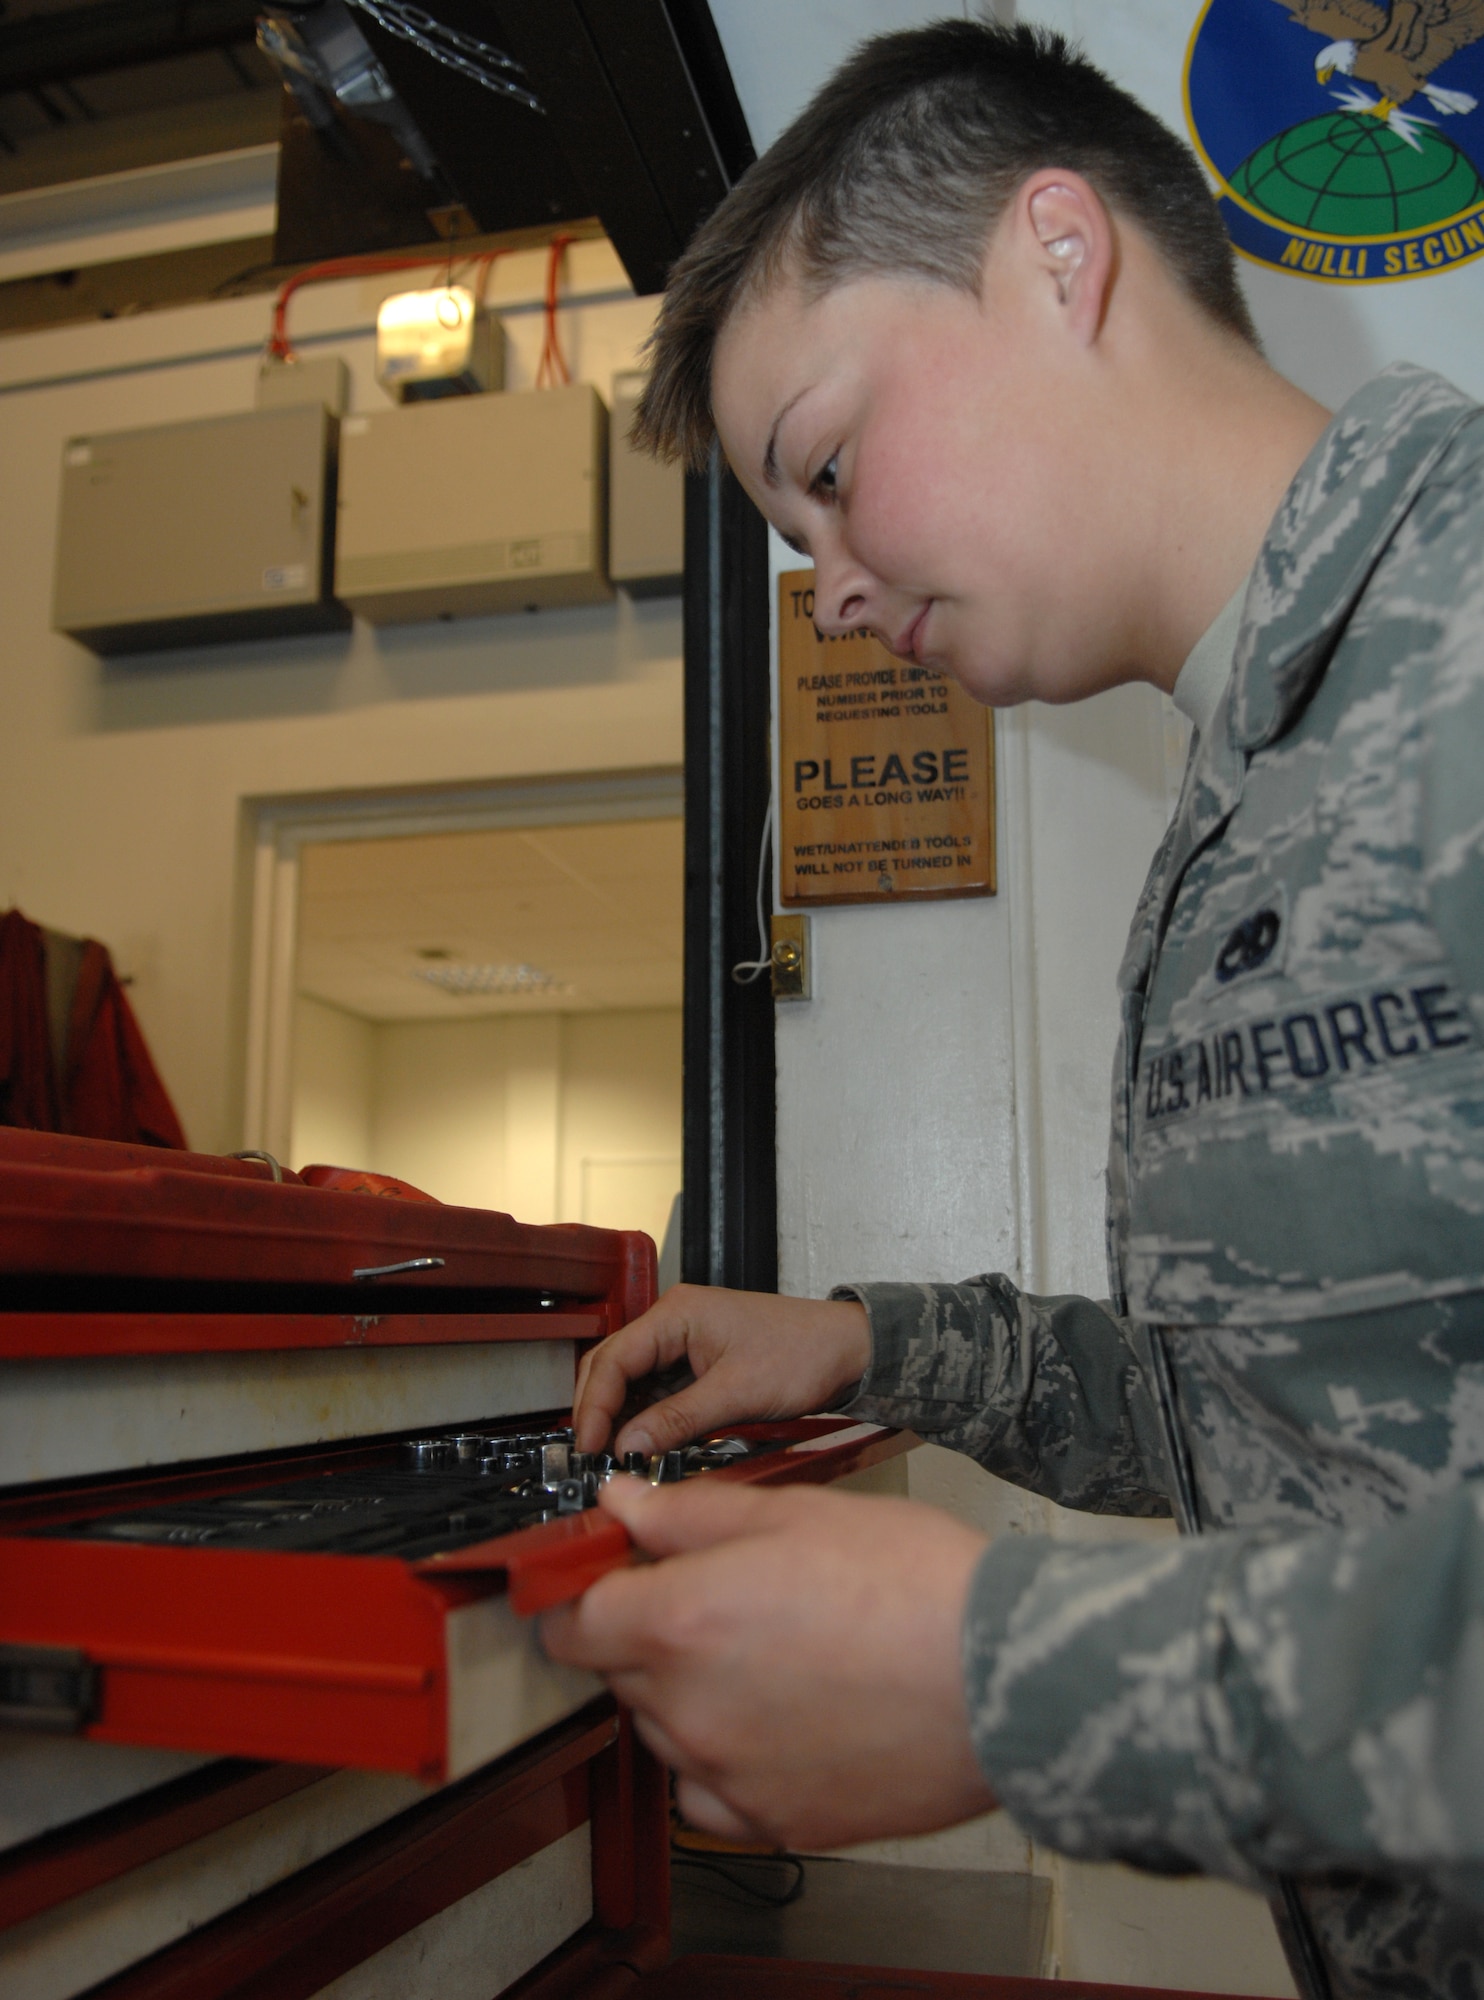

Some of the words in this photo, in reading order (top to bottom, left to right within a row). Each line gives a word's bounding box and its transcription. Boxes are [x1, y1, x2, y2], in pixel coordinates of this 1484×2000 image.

[1280, 238, 1367, 276] NULLI
[1384, 213, 1484, 274] SECUN
[797, 673, 842, 691] PLEASE
[846, 669, 896, 687] PROVIDE
[816, 692, 877, 708] NUMBER
[881, 687, 924, 702] PRIOR
[929, 685, 948, 698] TO
[816, 705, 900, 722] REQUESTING
[905, 702, 948, 716] TOOLS
[794, 749, 969, 793] PLEASE
[796, 795, 844, 811] GOES
[849, 794, 861, 807] A
[864, 790, 913, 806] LONG
[917, 786, 965, 803] WAY!!
[924, 835, 972, 850] TOOLS
[794, 862, 830, 875] WILL
[833, 860, 864, 874] NOT
[868, 859, 888, 872] BE
[892, 855, 953, 871] TURNED
[957, 854, 972, 867] IN
[1197, 1029, 1251, 1105] AIR
[1251, 984, 1469, 1092] FORCE
